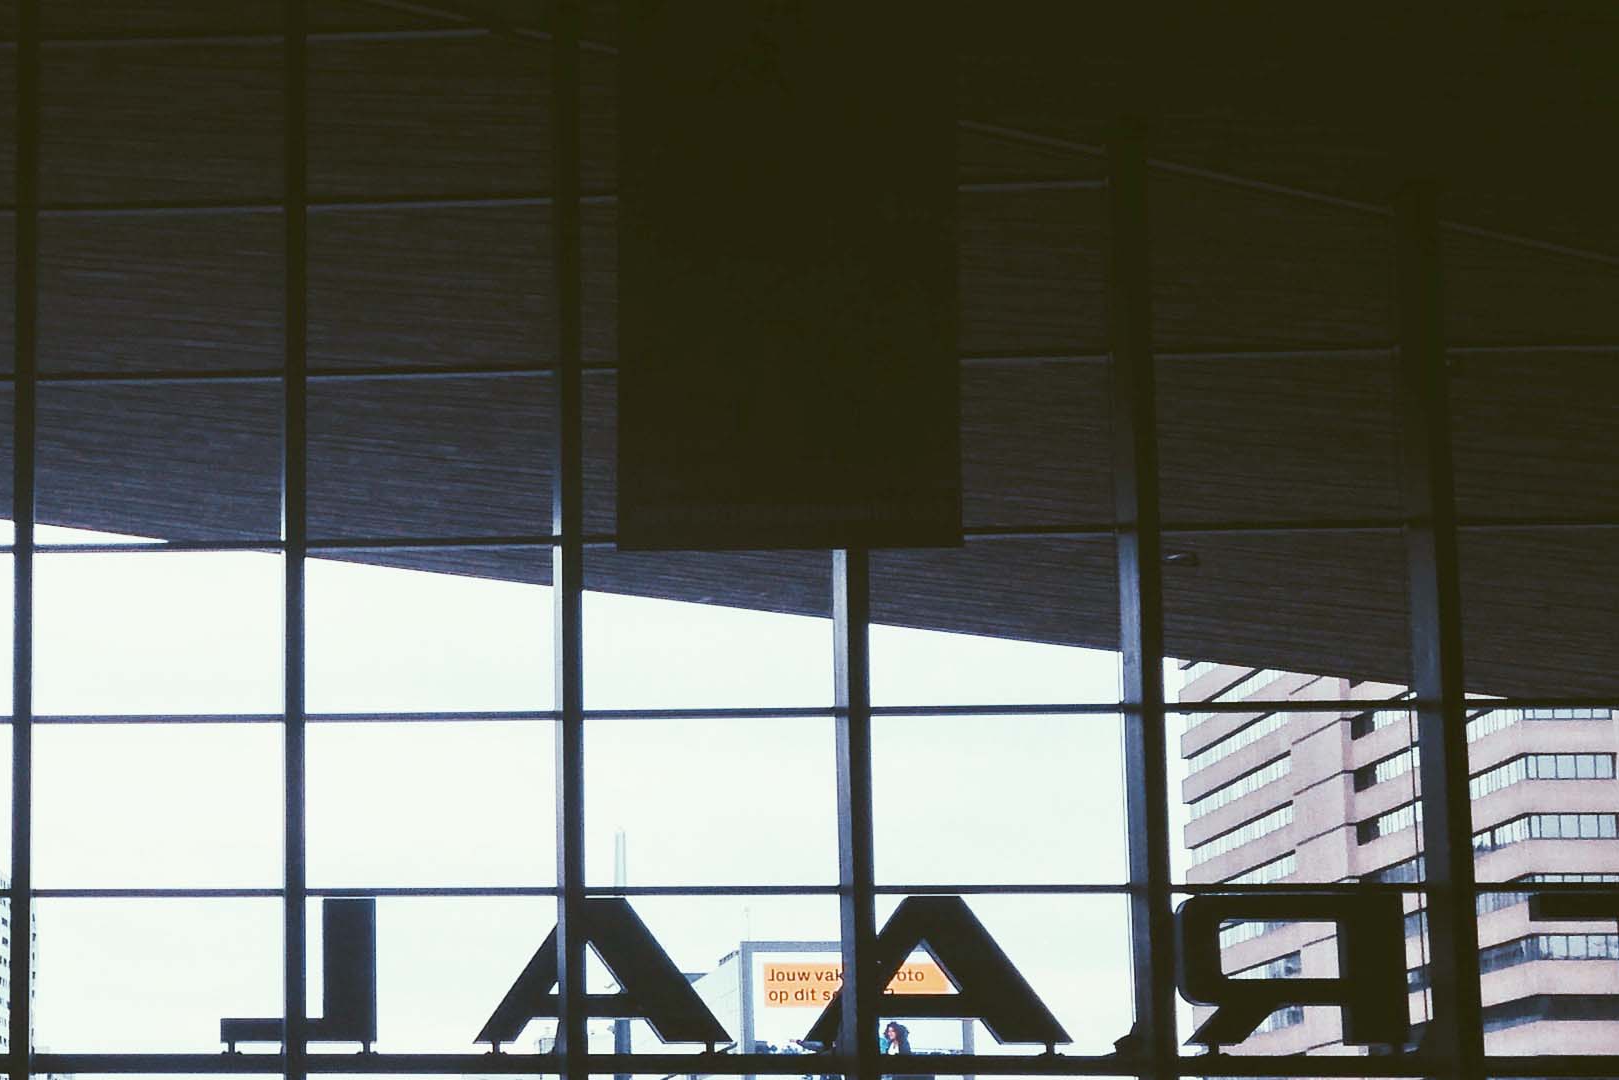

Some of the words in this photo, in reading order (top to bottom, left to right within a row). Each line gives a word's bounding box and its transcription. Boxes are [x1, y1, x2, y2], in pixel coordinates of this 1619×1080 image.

[768, 968, 811, 982] Jouw
[768, 990, 789, 1004] op
[794, 988, 817, 1001] dit
